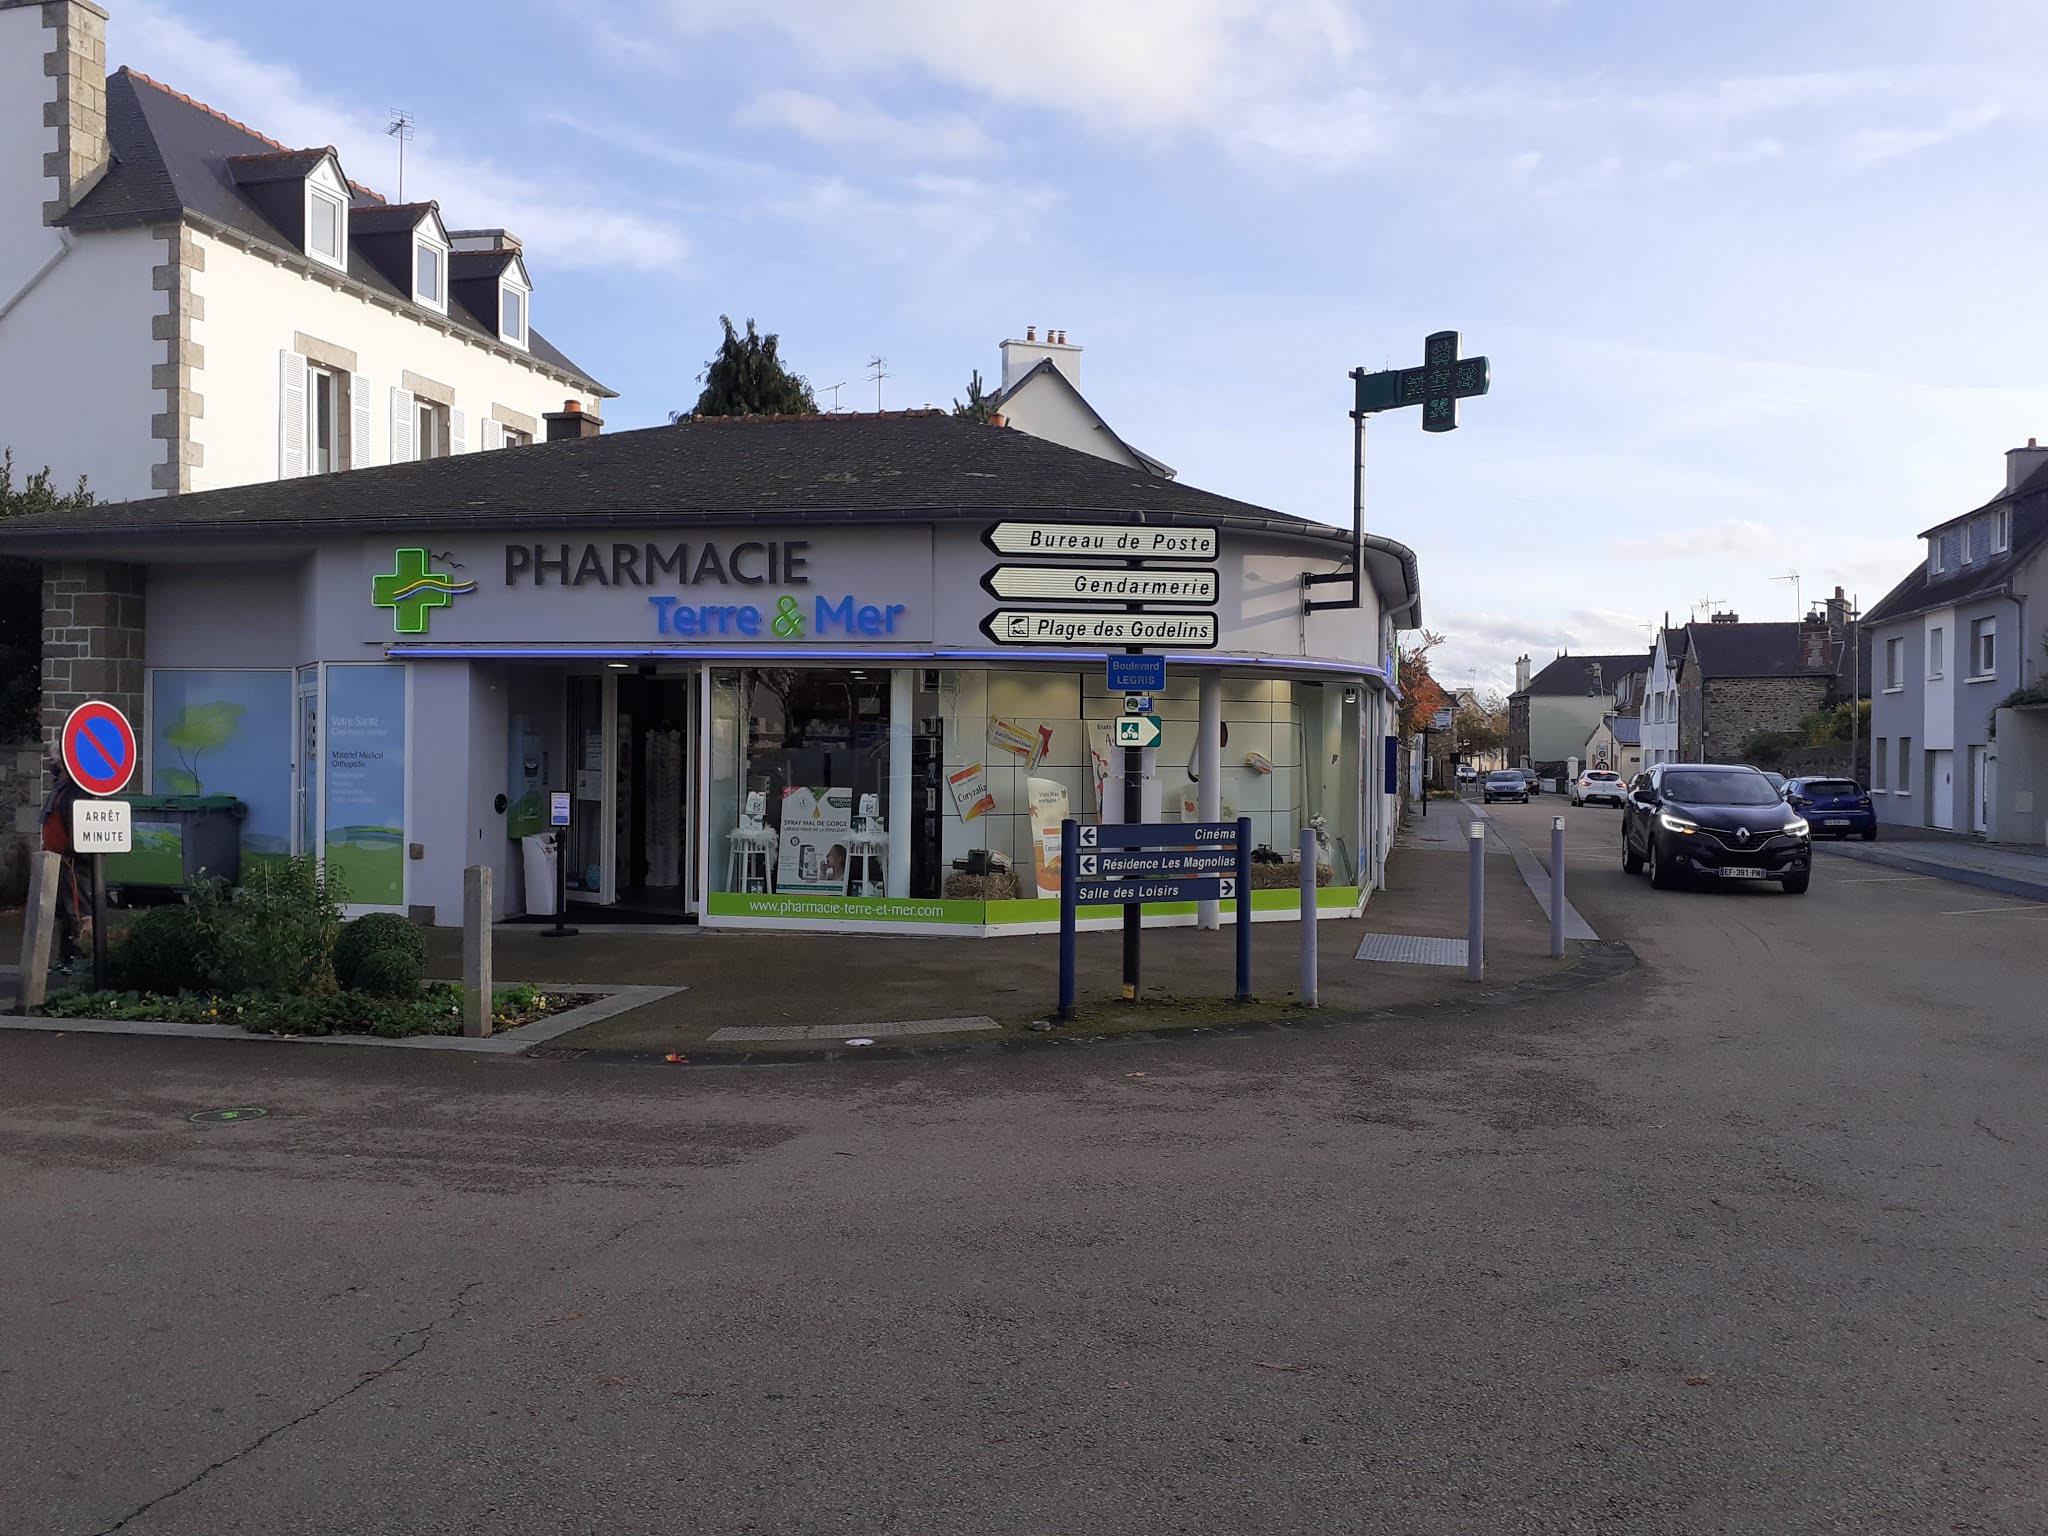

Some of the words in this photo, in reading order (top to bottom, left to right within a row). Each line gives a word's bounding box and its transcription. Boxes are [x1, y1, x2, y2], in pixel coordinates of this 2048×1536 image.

[1030, 530, 1104, 548] Bureau
[1117, 533, 1140, 549] de
[1152, 534, 1210, 551] Poste
[505, 541, 809, 586] PHARMACIE
[1074, 576, 1209, 595] Gendarmerie
[648, 596, 762, 634] Terre
[771, 595, 805, 638] &
[815, 595, 905, 634] Mer
[1037, 619, 1086, 640] Plage
[1093, 620, 1124, 637] des
[1131, 621, 1209, 638] Godelins
[1112, 661, 1160, 671] Boulevard
[1117, 675, 1155, 685] LEGRIS
[957, 783, 987, 803] Coryzalia
[85, 809, 120, 821] ARRÊT
[82, 832, 124, 842] MINUTE
[1194, 828, 1236, 840] Cinéma
[1102, 858, 1159, 871] Résidence
[1161, 857, 1181, 869] Les
[1183, 856, 1236, 870] Magnolias
[1079, 887, 1109, 900] Salle
[1113, 886, 1135, 898] des
[1138, 885, 1179, 897] Loisirs
[749, 900, 944, 917] www.pharmacie-terre-et-mer.com
